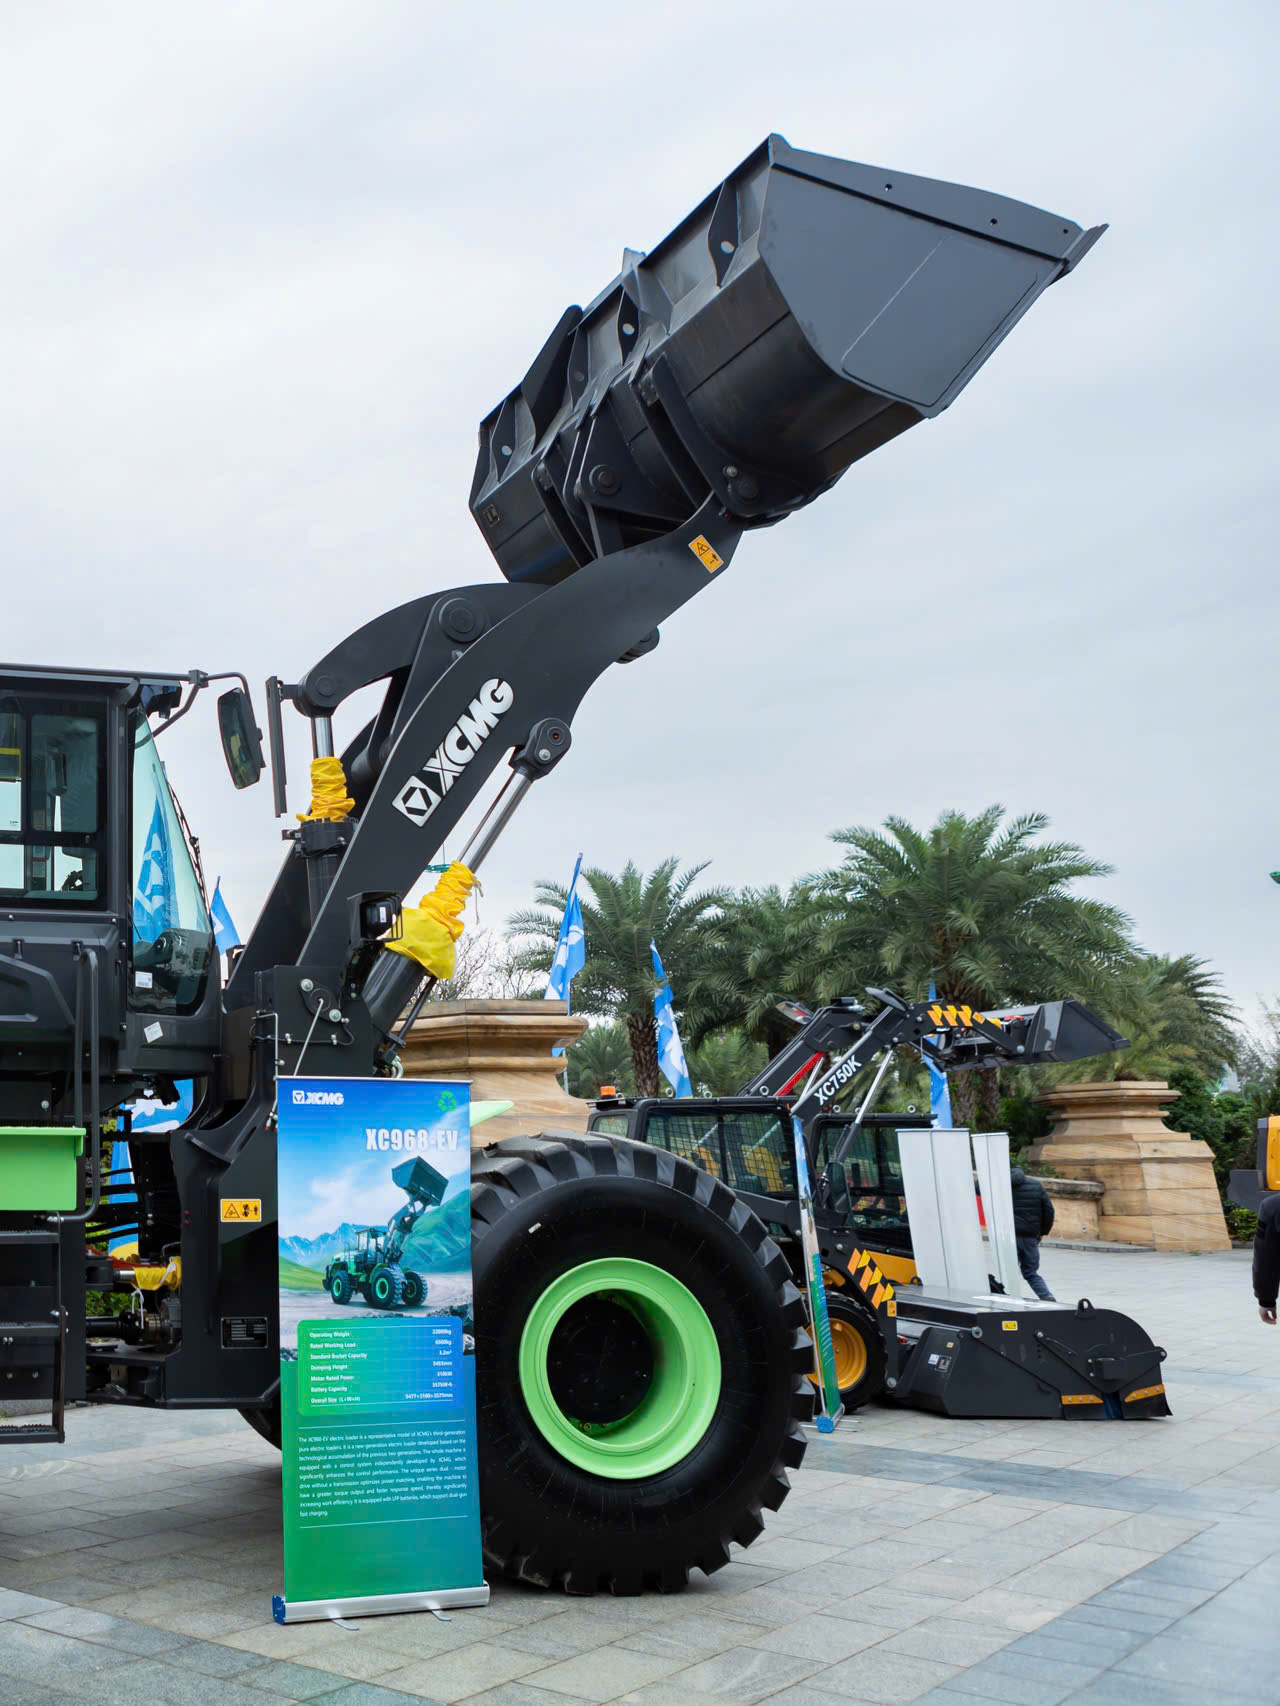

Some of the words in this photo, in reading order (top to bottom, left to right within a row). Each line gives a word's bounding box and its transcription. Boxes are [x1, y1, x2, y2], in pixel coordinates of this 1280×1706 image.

[422, 678, 514, 797] XCMG
[305, 1092, 345, 1105] XCMG
[813, 1054, 862, 1106] XC750K
[365, 1128, 459, 1151] XC968-EV
